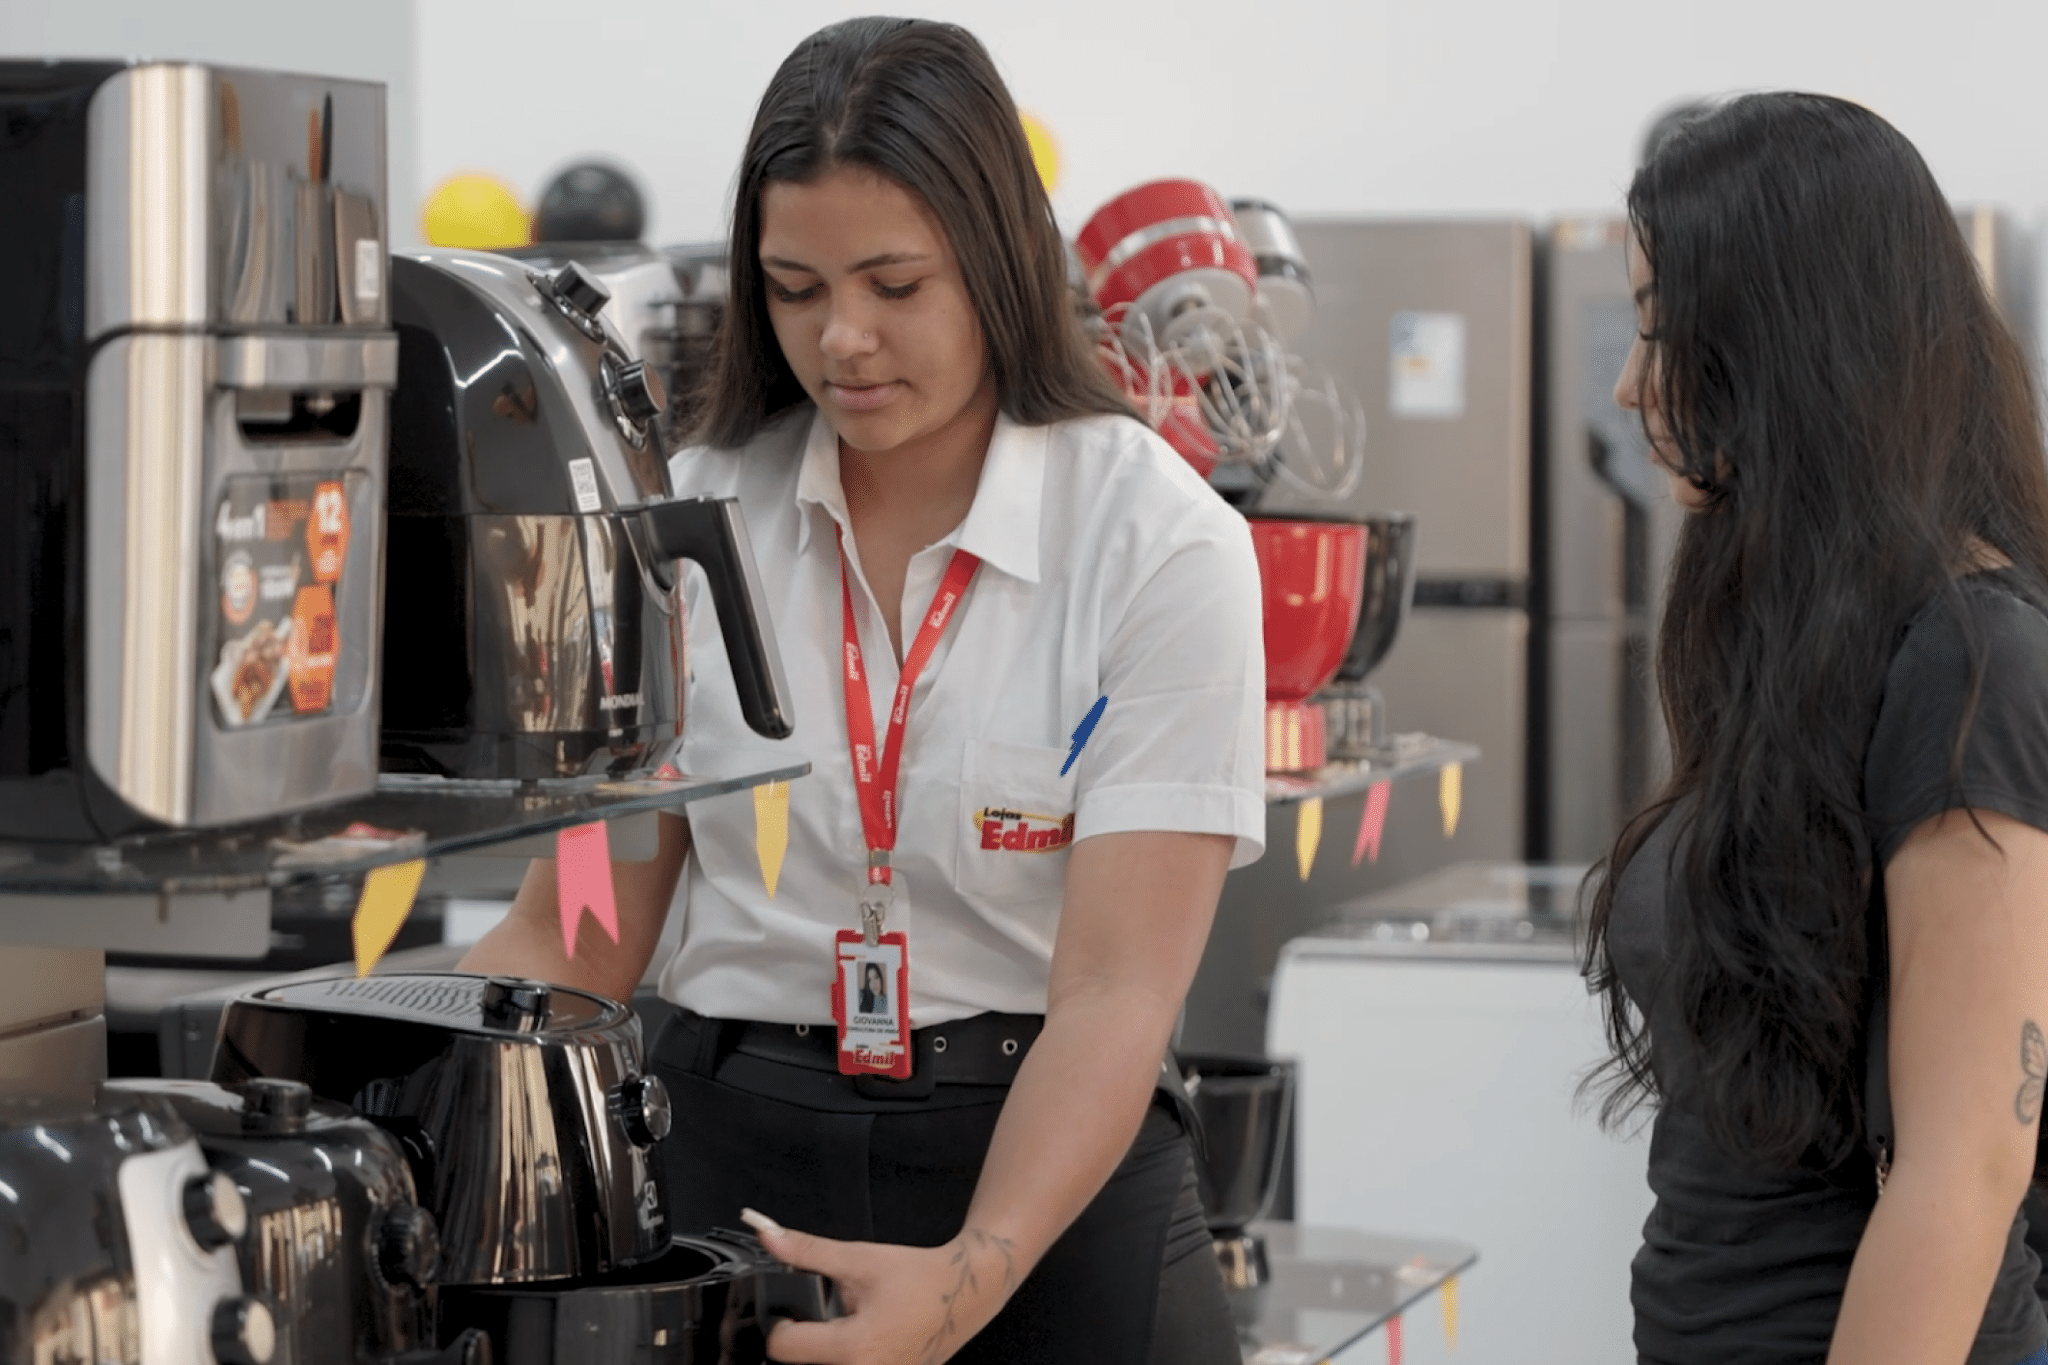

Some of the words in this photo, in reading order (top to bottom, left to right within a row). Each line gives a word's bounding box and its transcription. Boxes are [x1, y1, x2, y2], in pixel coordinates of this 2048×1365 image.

[984, 806, 1022, 821] Lojas
[853, 1016, 893, 1026] GIOVANNA
[854, 1049, 894, 1064] Edmil
